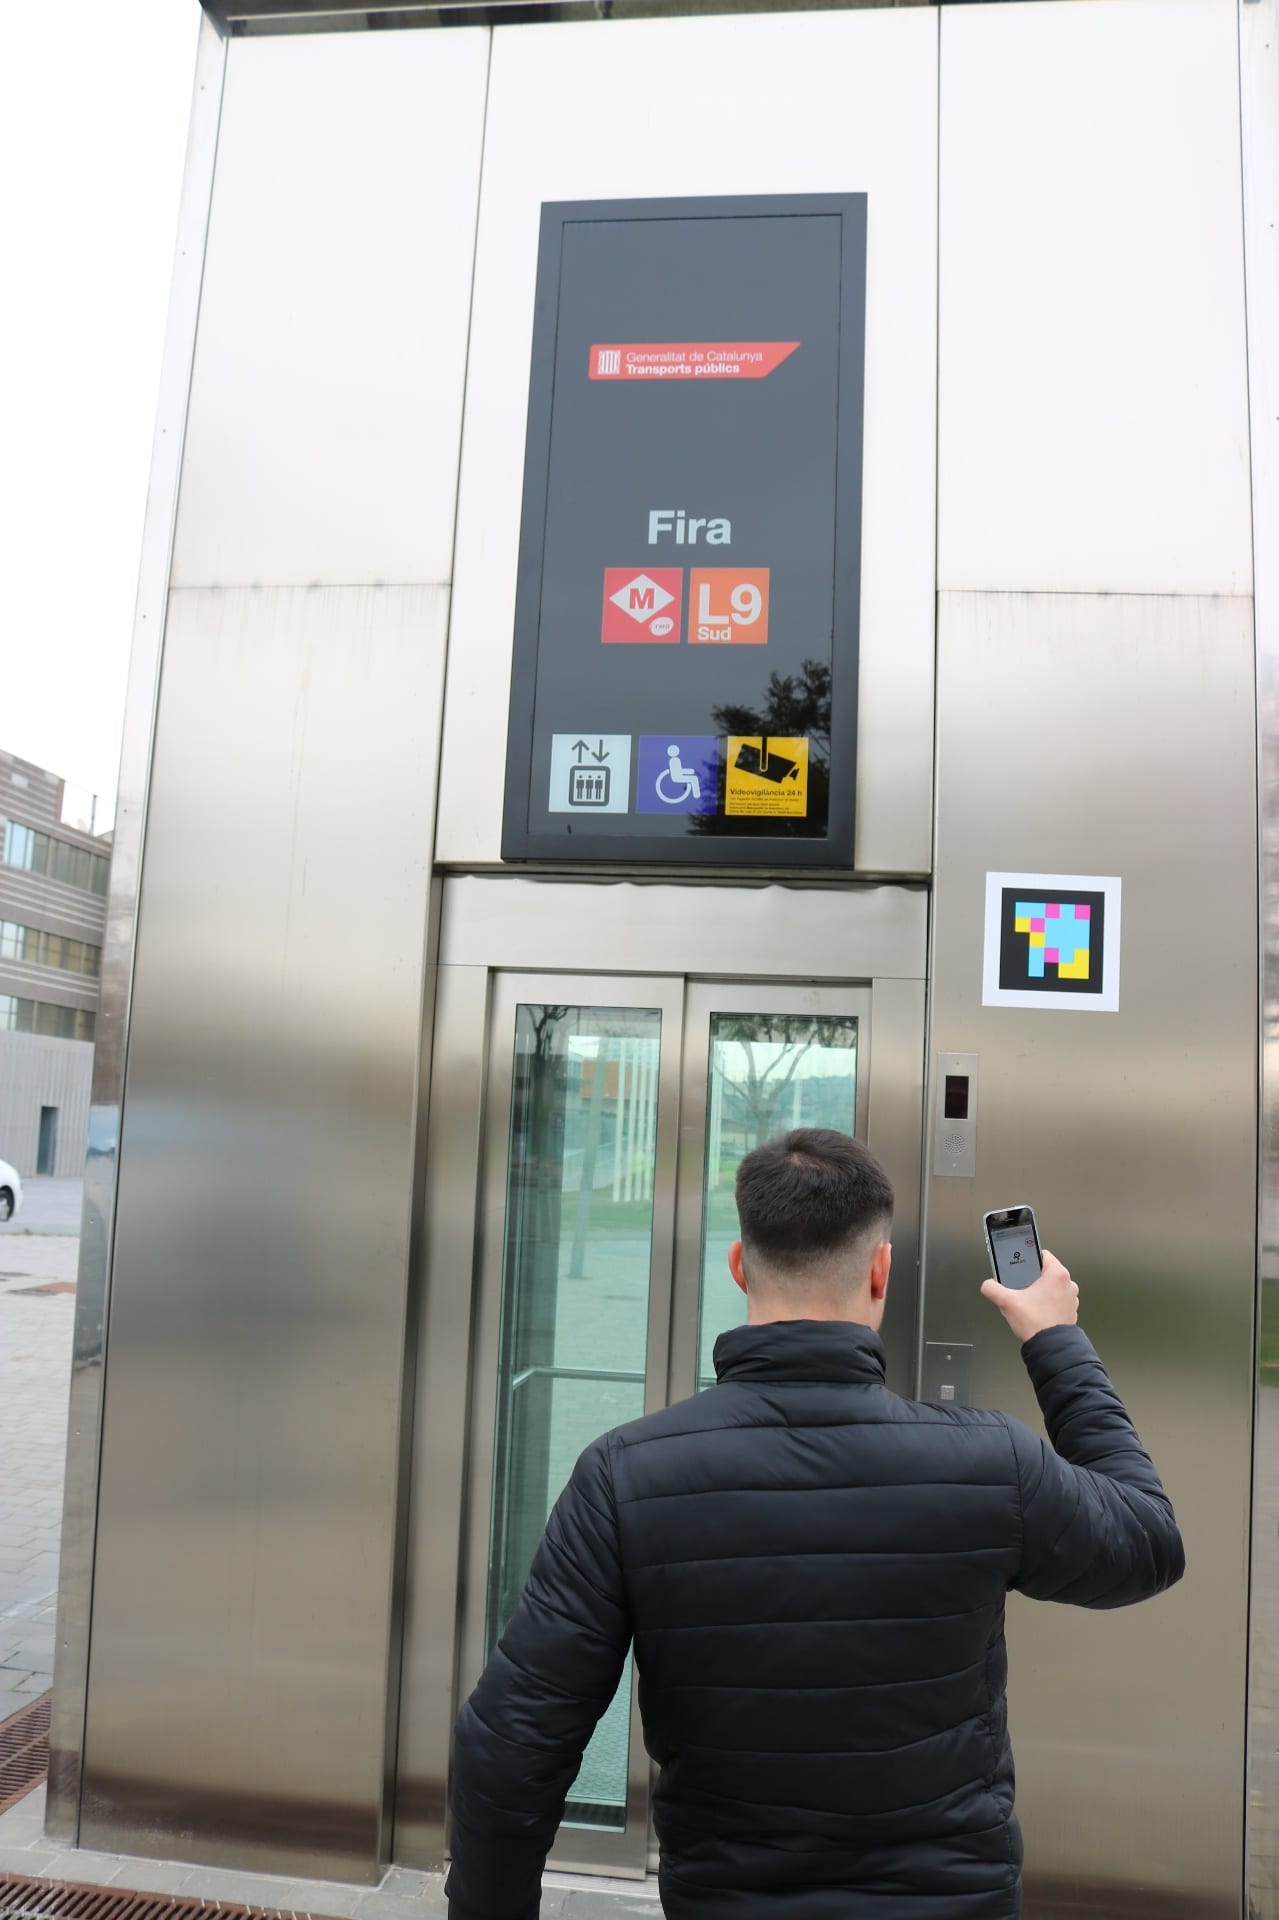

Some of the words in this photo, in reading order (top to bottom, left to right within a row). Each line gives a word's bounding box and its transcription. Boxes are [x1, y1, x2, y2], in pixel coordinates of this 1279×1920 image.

[626, 351, 686, 362] Generalitat
[689, 351, 704, 361] de
[706, 350, 763, 363] Catalunya
[626, 363, 691, 376] Transports
[695, 363, 740, 375] públics
[648, 510, 732, 545] Fira
[629, 588, 655, 609] M
[698, 583, 762, 626] L9
[697, 626, 732, 641] Sud
